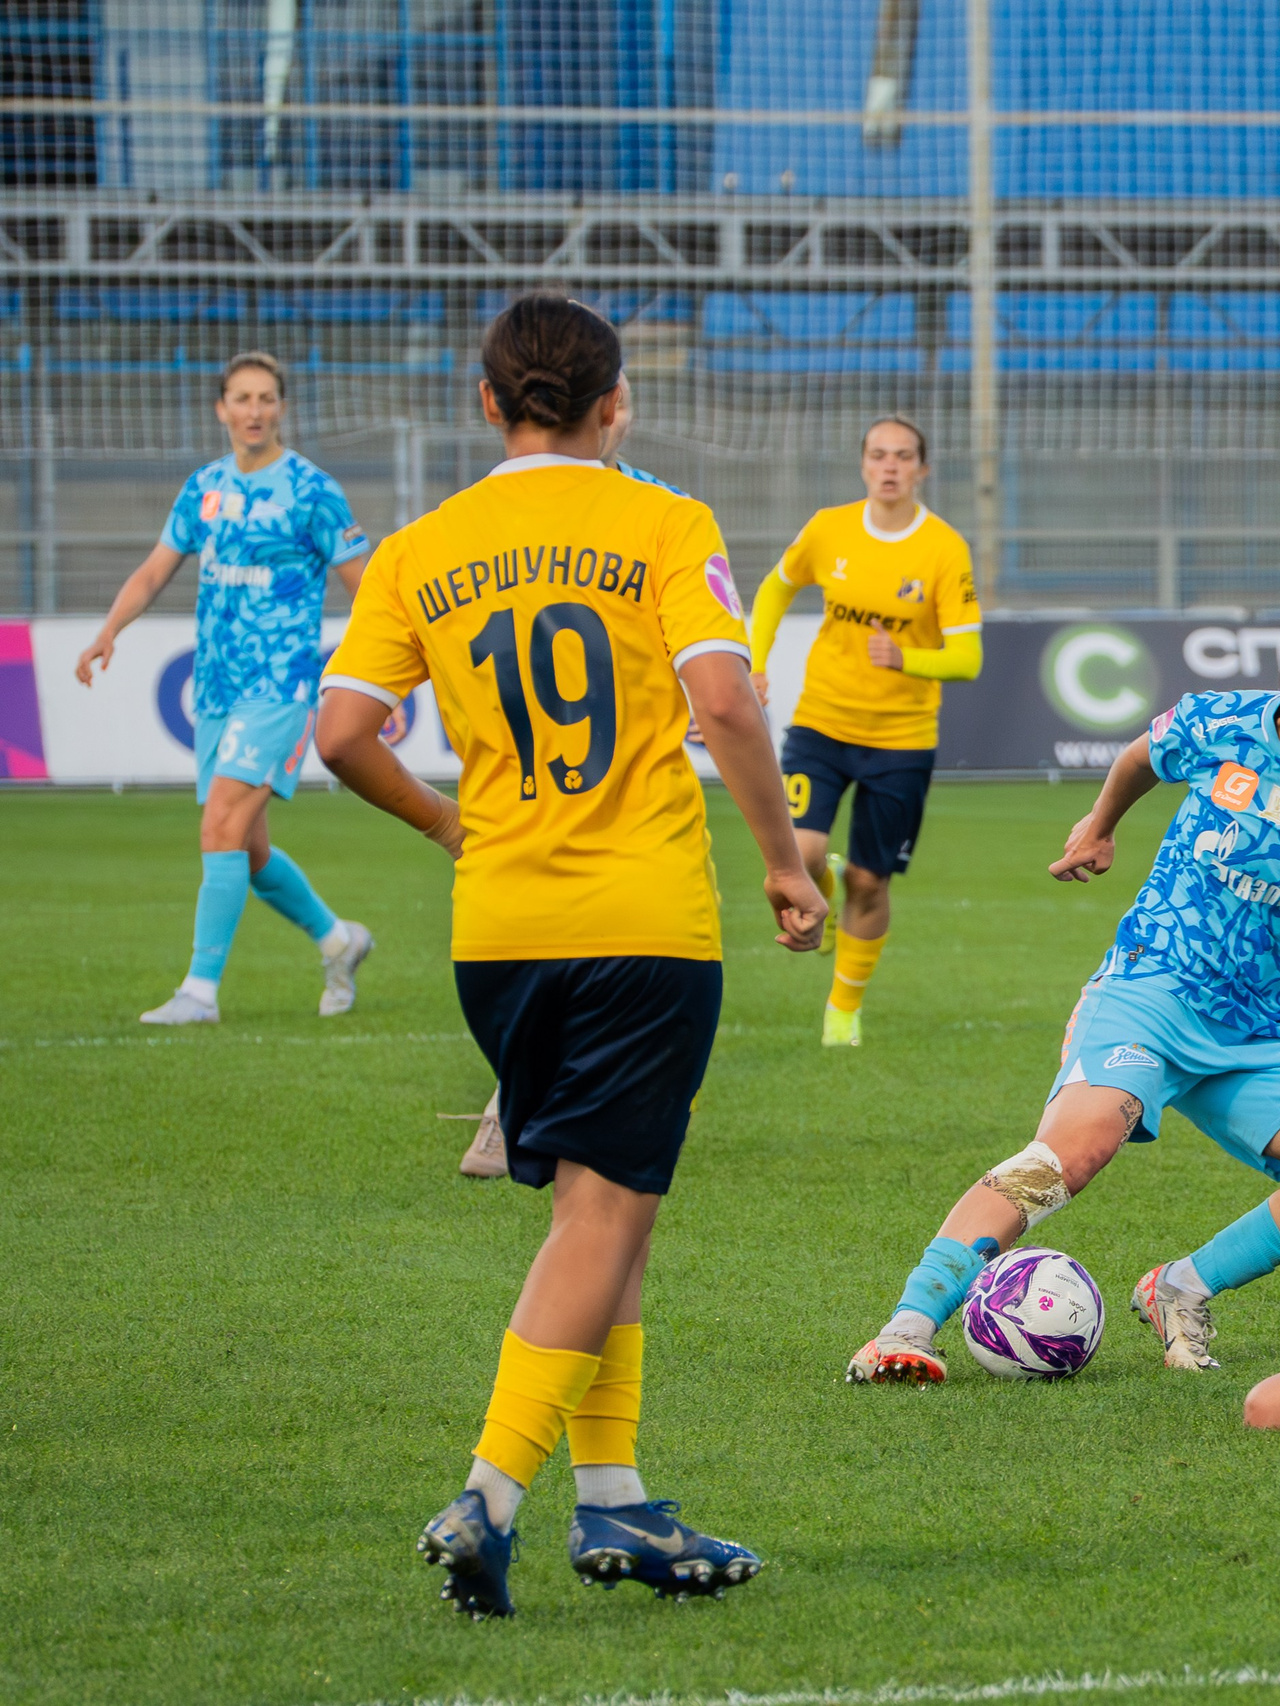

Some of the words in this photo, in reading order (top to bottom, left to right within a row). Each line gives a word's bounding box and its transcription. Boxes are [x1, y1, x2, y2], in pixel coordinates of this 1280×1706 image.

[416, 545, 647, 624] ШЕРШУНОВА
[469, 602, 617, 801] 19
[782, 772, 811, 818] 9
[1224, 772, 1256, 796] G
